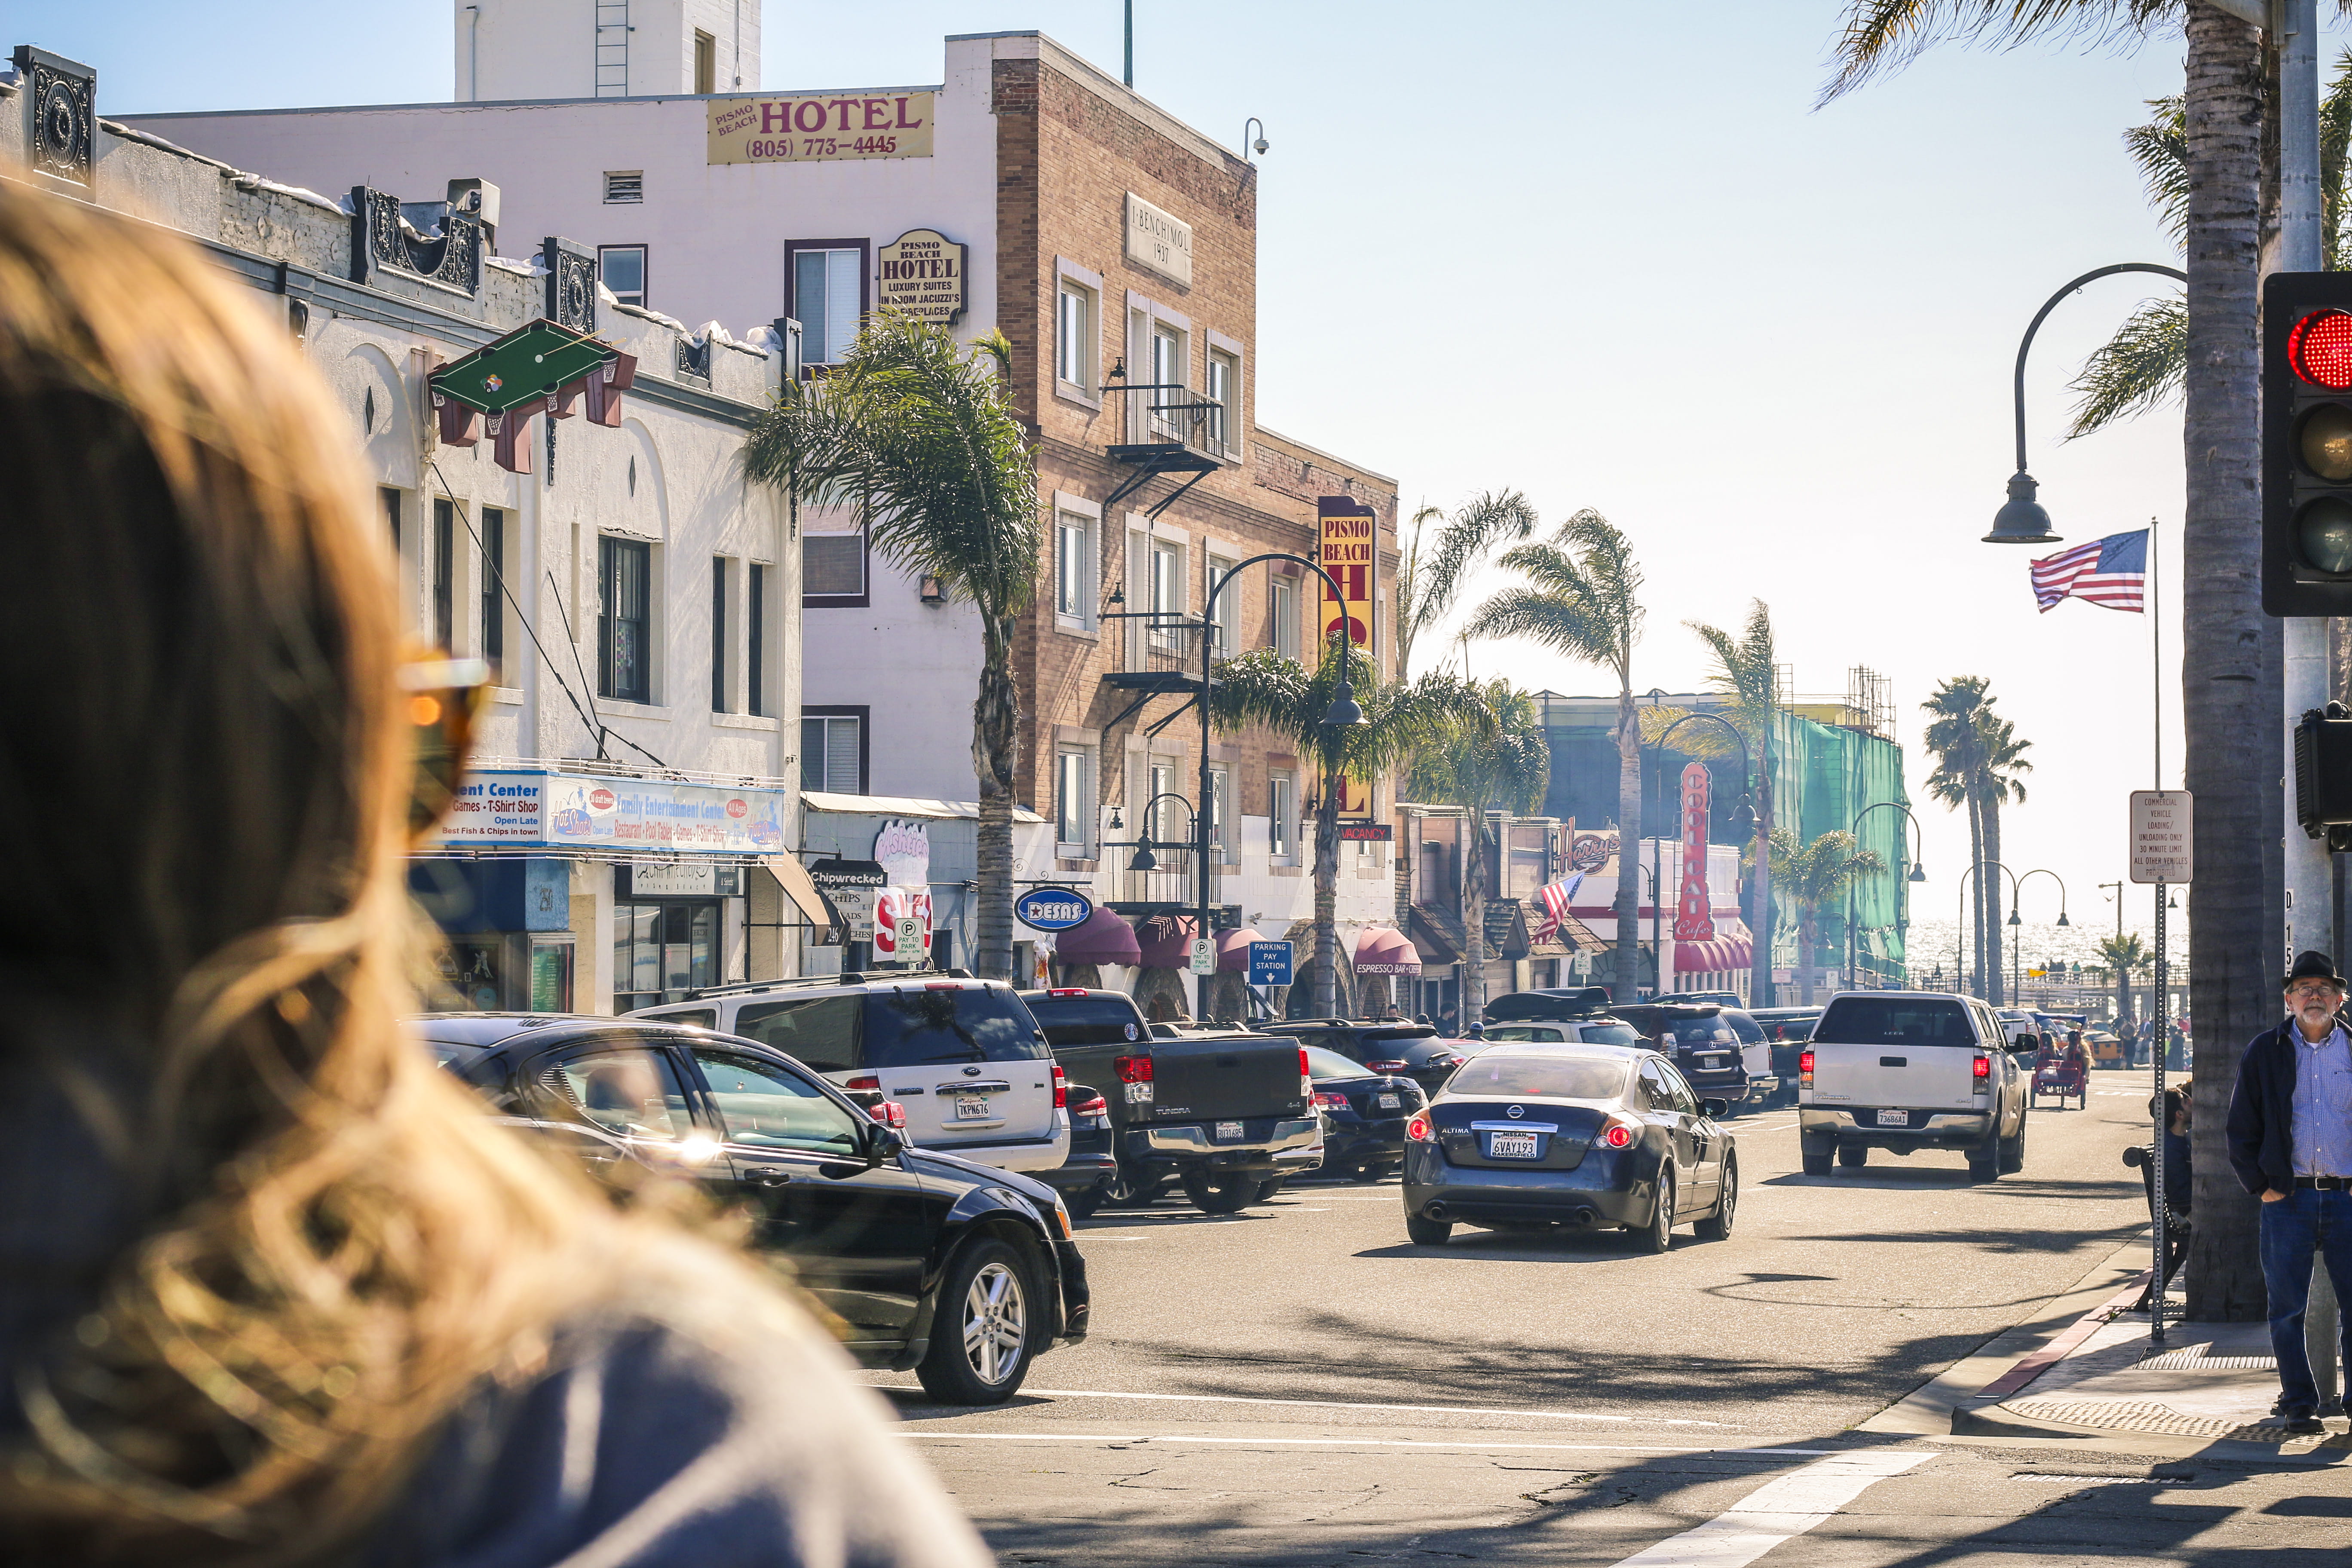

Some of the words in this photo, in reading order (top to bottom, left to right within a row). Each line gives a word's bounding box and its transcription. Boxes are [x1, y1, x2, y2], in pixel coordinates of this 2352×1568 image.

[715, 104, 753, 125] PISMO
[760, 98, 922, 134] HOTEL
[718, 114, 757, 136] BEACH
[746, 139, 793, 159] (805)
[803, 136, 896, 156] 773-4445
[900, 251, 940, 259] BEACH
[1154, 242, 1168, 264] 1937
[883, 259, 958, 279] HOTEL
[888, 283, 921, 291] LUXURY
[923, 282, 952, 290] SUITES
[881, 296, 889, 304] IN
[919, 294, 959, 303] JACUZZI'S
[1325, 521, 1369, 538] PISMO
[1324, 544, 1370, 560] BEACH
[489, 783, 538, 796] Center
[590, 794, 594, 802] 30
[604, 795, 613, 804] beers
[453, 800, 480, 812] Games
[488, 800, 515, 812] T-Shirt
[518, 801, 538, 812] Shop
[617, 793, 643, 820] Family
[645, 796, 699, 819] Entertainment
[701, 800, 725, 820] Center
[736, 804, 746, 815] Ages
[1687, 774, 1703, 846] COOL
[495, 817, 517, 825] Open
[551, 801, 570, 832] Hot
[593, 827, 603, 835] Open
[604, 826, 613, 835] Late
[615, 819, 642, 839] Restaurant
[646, 821, 657, 840] Pool
[658, 821, 672, 841] Tables
[677, 823, 692, 842] Games
[696, 824, 712, 842] T-Shirt
[713, 825, 724, 843] Shop
[2148, 821, 2174, 829] LOADING/
[1341, 828, 1385, 839] VACANCY
[1554, 817, 1620, 872] Harry's
[889, 861, 917, 873] BEACH
[724, 878, 733, 886] Salads
[811, 872, 883, 884] Chipwrecked
[1684, 860, 1702, 914] CAT
[2287, 891, 2292, 909] D
[1028, 902, 1081, 921] DESAS
[828, 927, 838, 942] 246
[906, 925, 913, 934] P
[1357, 964, 1393, 973] ESPRESSO
[1395, 965, 1406, 973] BAR
[959, 1104, 988, 1115] 7KPN676
[1218, 1128, 1242, 1138] 8U31685
[1494, 1142, 1533, 1153] 6VAY193
